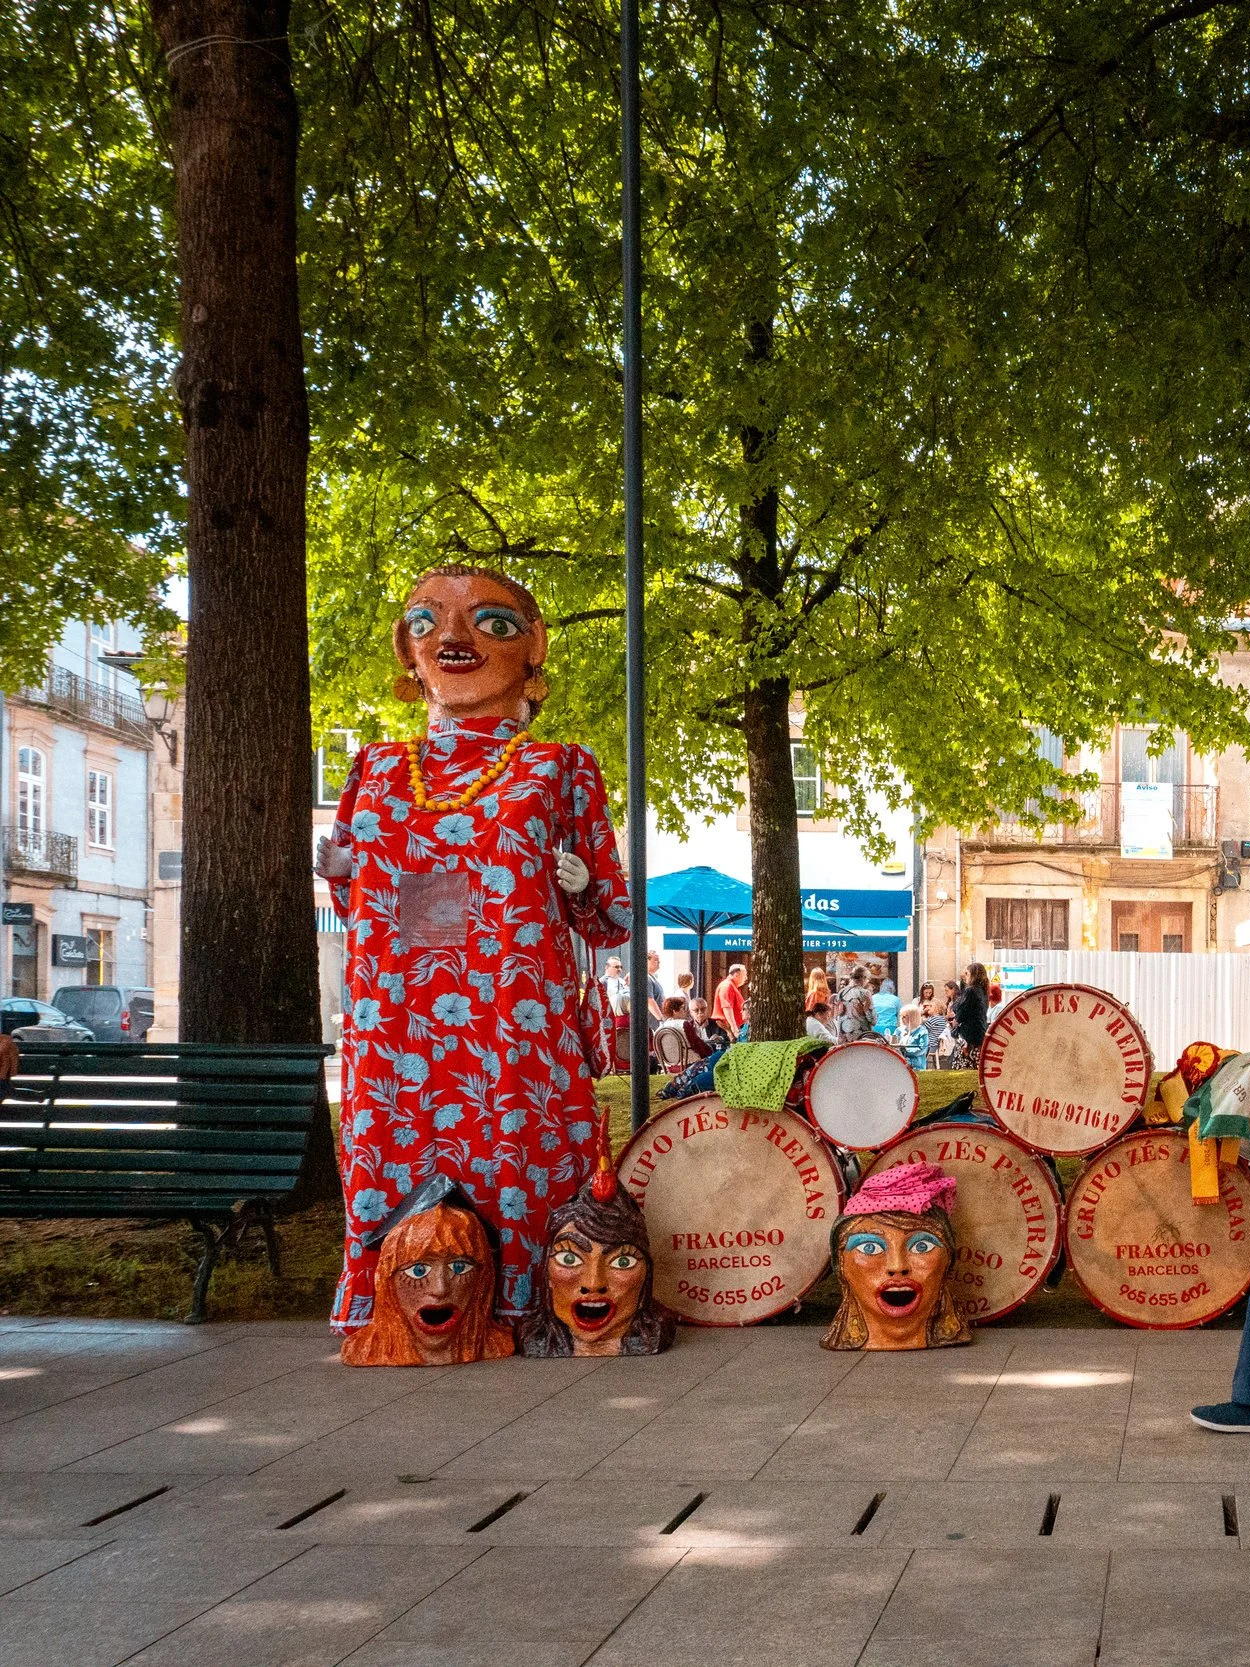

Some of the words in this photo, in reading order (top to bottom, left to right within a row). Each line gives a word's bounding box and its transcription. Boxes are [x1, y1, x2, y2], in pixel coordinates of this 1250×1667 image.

[724, 937, 752, 947] MAÎTR
[983, 1006, 1030, 1079] GRUPO
[1038, 990, 1080, 1016] ZÉS
[997, 1089, 1026, 1113] TEL
[1032, 1096, 1120, 1133] 058/971642
[628, 1134, 673, 1210] RUPO
[677, 1106, 729, 1140] ZÉS
[936, 1136, 988, 1164] ZÉS
[1077, 1161, 1121, 1241] GRUPO
[1125, 1140, 1170, 1167] ZÉS
[672, 1228, 785, 1250] FRAGOSO
[1115, 1242, 1211, 1260] FRAGOSO
[687, 1254, 771, 1271] BARCELOS
[1128, 1264, 1199, 1276] BARCELOS
[677, 1280, 710, 1303] 965
[713, 1289, 747, 1305] 655
[750, 1275, 785, 1301] 602
[1118, 1283, 1146, 1304] 965
[1148, 1292, 1178, 1306] 655
[1181, 1281, 1211, 1303] 602
